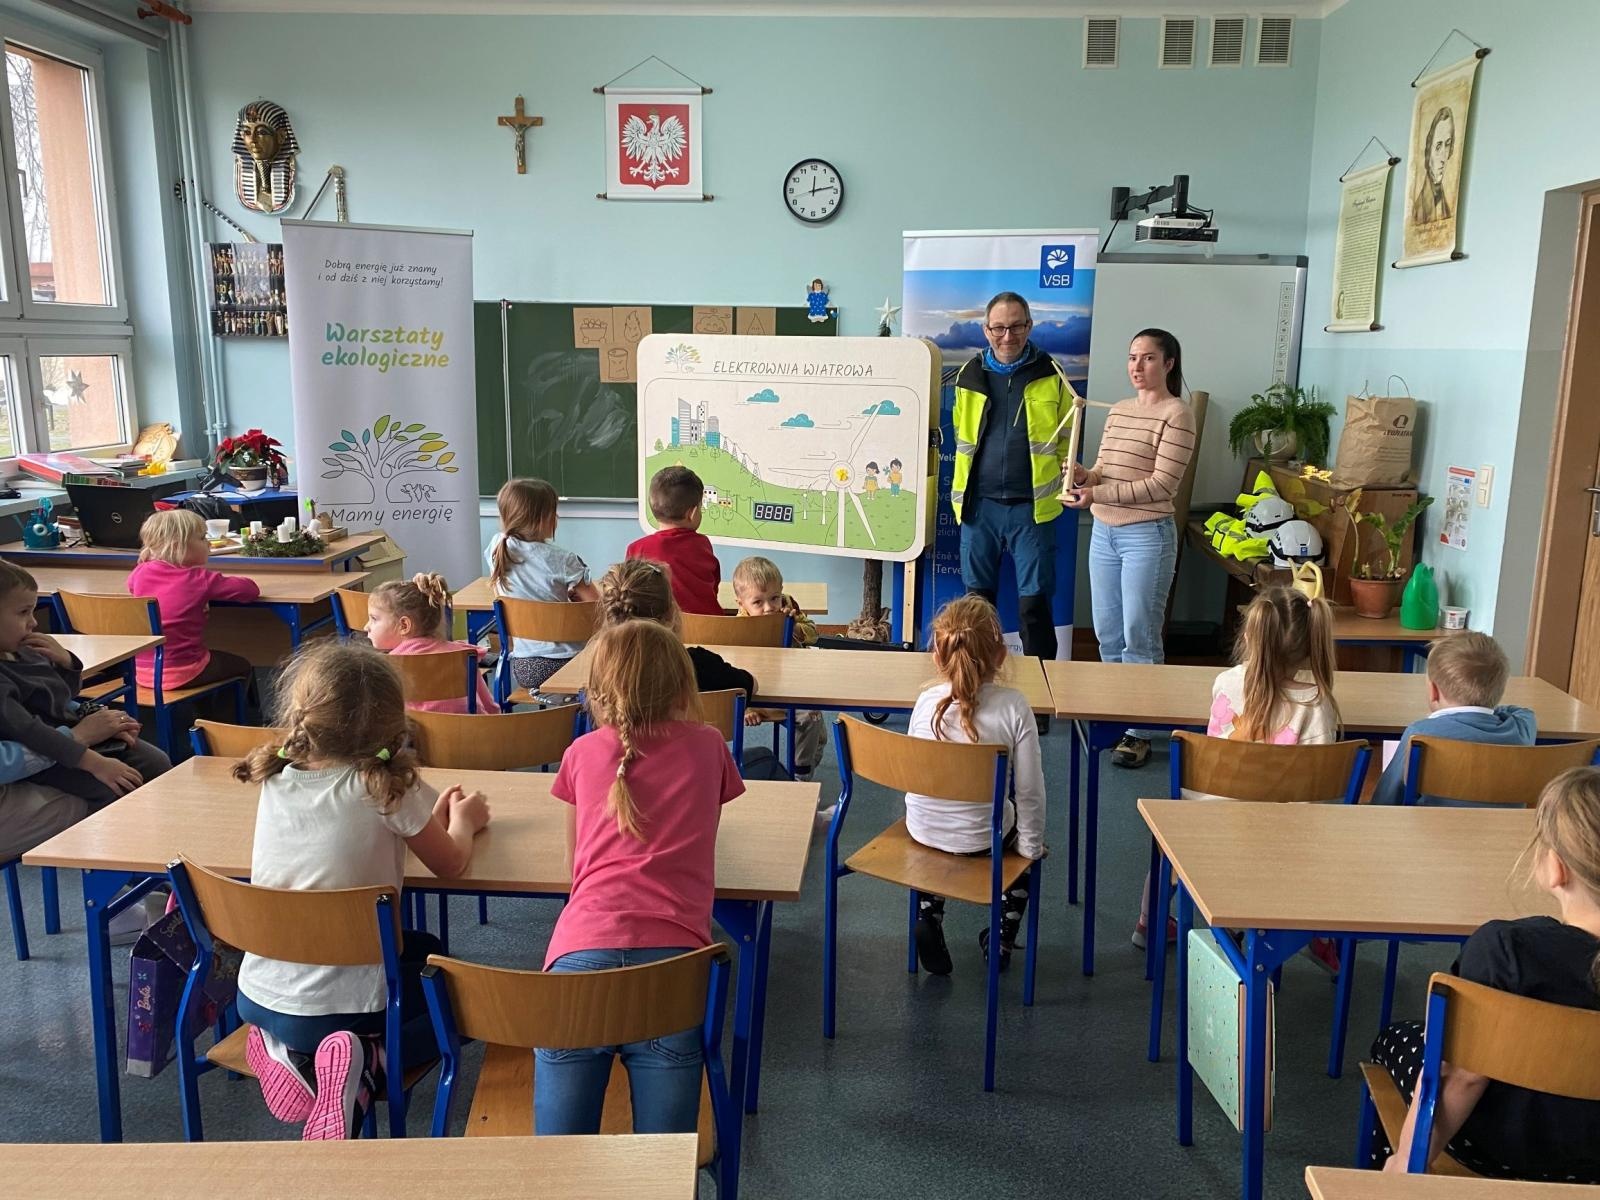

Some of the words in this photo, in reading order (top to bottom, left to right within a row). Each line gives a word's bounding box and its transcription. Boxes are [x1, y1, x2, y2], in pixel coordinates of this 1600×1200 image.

[324, 259, 351, 272] Dobrą
[355, 262, 387, 274] energię
[389, 263, 404, 274] już
[408, 265, 437, 275] znamy
[318, 272, 322, 281] i
[325, 272, 337, 282] od
[340, 273, 358, 283] dziś
[371, 275, 387, 286] niej
[391, 277, 444, 288] korzystamy!
[1043, 274, 1070, 286] VSB
[325, 322, 445, 350] Warsztaty
[321, 345, 449, 373] ekologiczne
[713, 360, 799, 376] ELEKTROWNIA
[803, 362, 873, 377] WIATROWA
[330, 508, 385, 526] Mamy
[392, 505, 453, 524] energię
